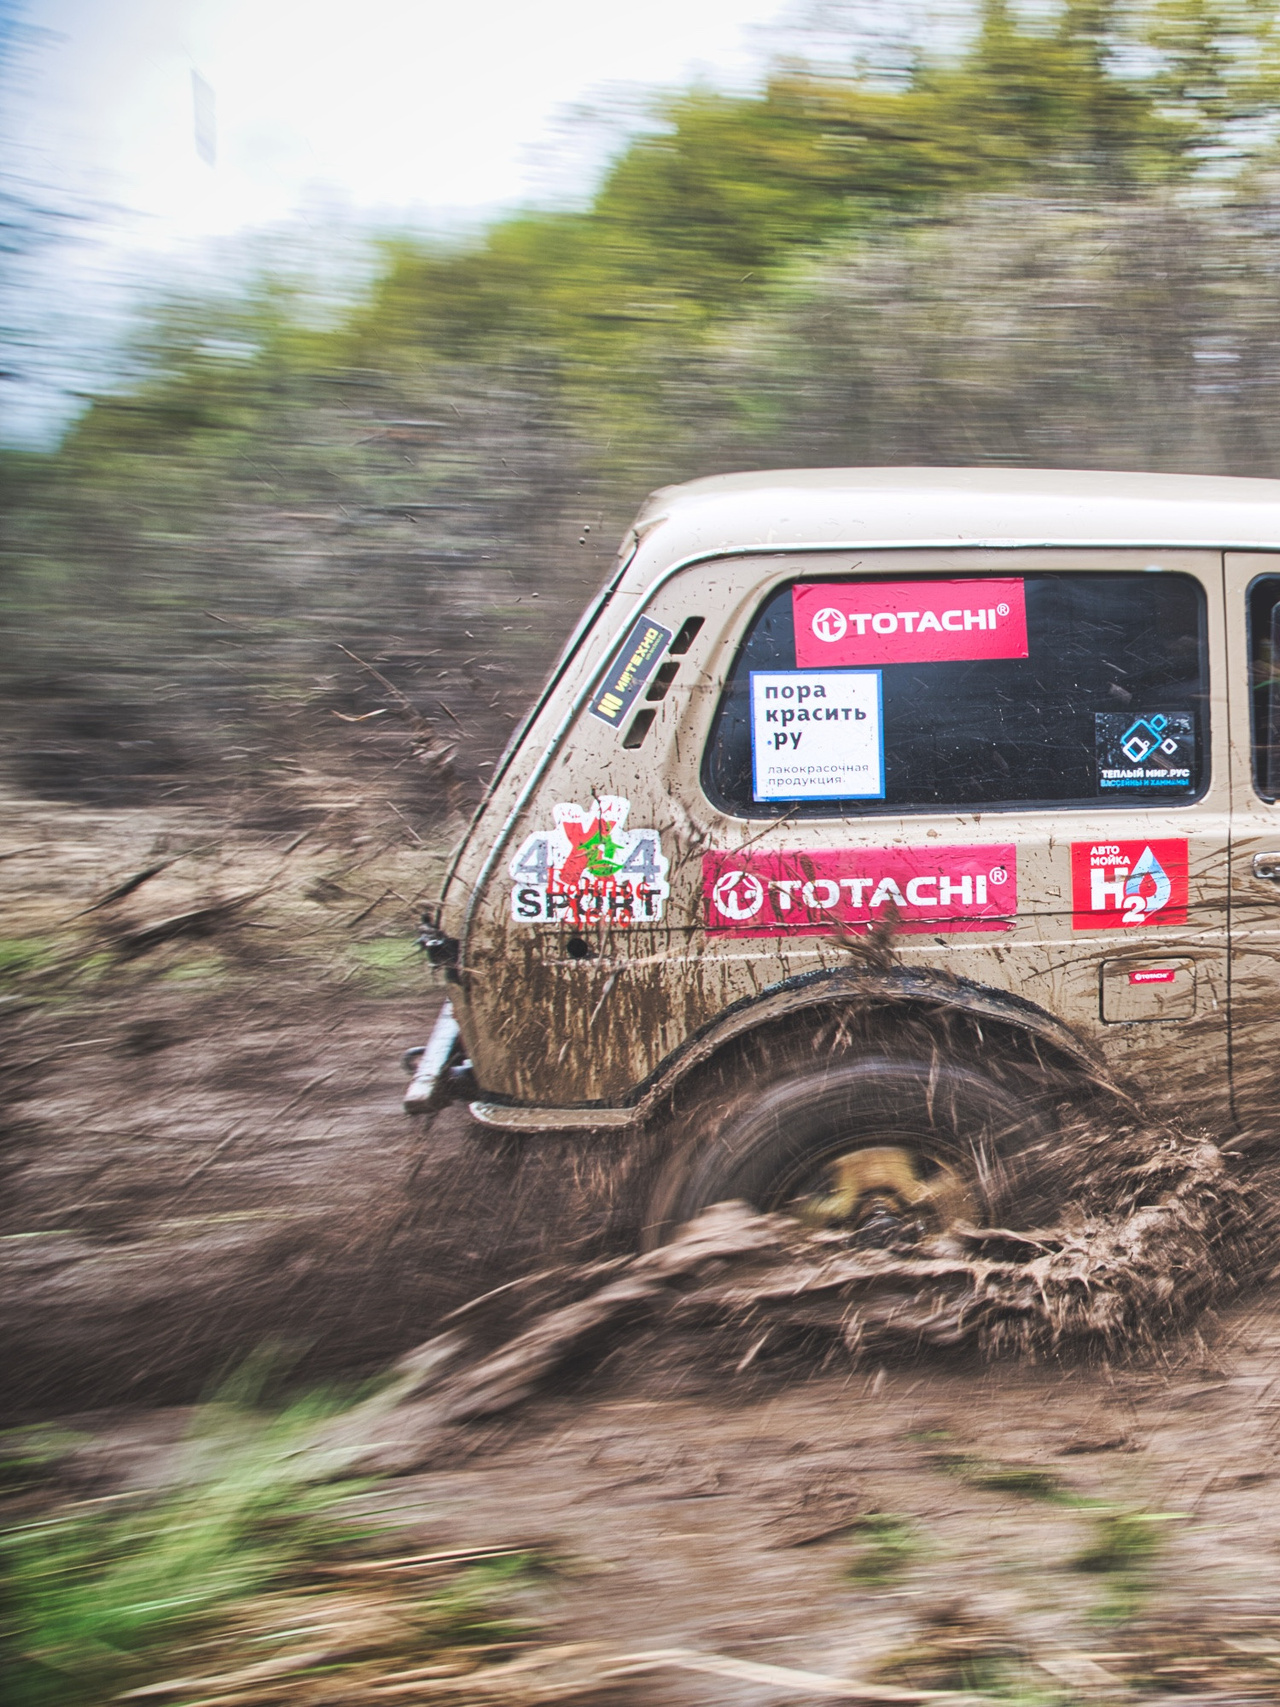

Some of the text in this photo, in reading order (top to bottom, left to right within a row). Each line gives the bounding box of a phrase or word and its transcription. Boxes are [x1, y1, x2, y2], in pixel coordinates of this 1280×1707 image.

[765, 685, 827, 703] пора
[766, 708, 867, 727] красить
[767, 732, 803, 750] .ру
[768, 764, 869, 774] лакокрасочная
[1102, 768, 1190, 778] ТЕПЛЫЙ МИР.РУС
[768, 777, 842, 787] продукция
[1090, 846, 1120, 855] АВТО
[1091, 855, 1130, 866] МОЙКА
[517, 888, 661, 918] SPORT
